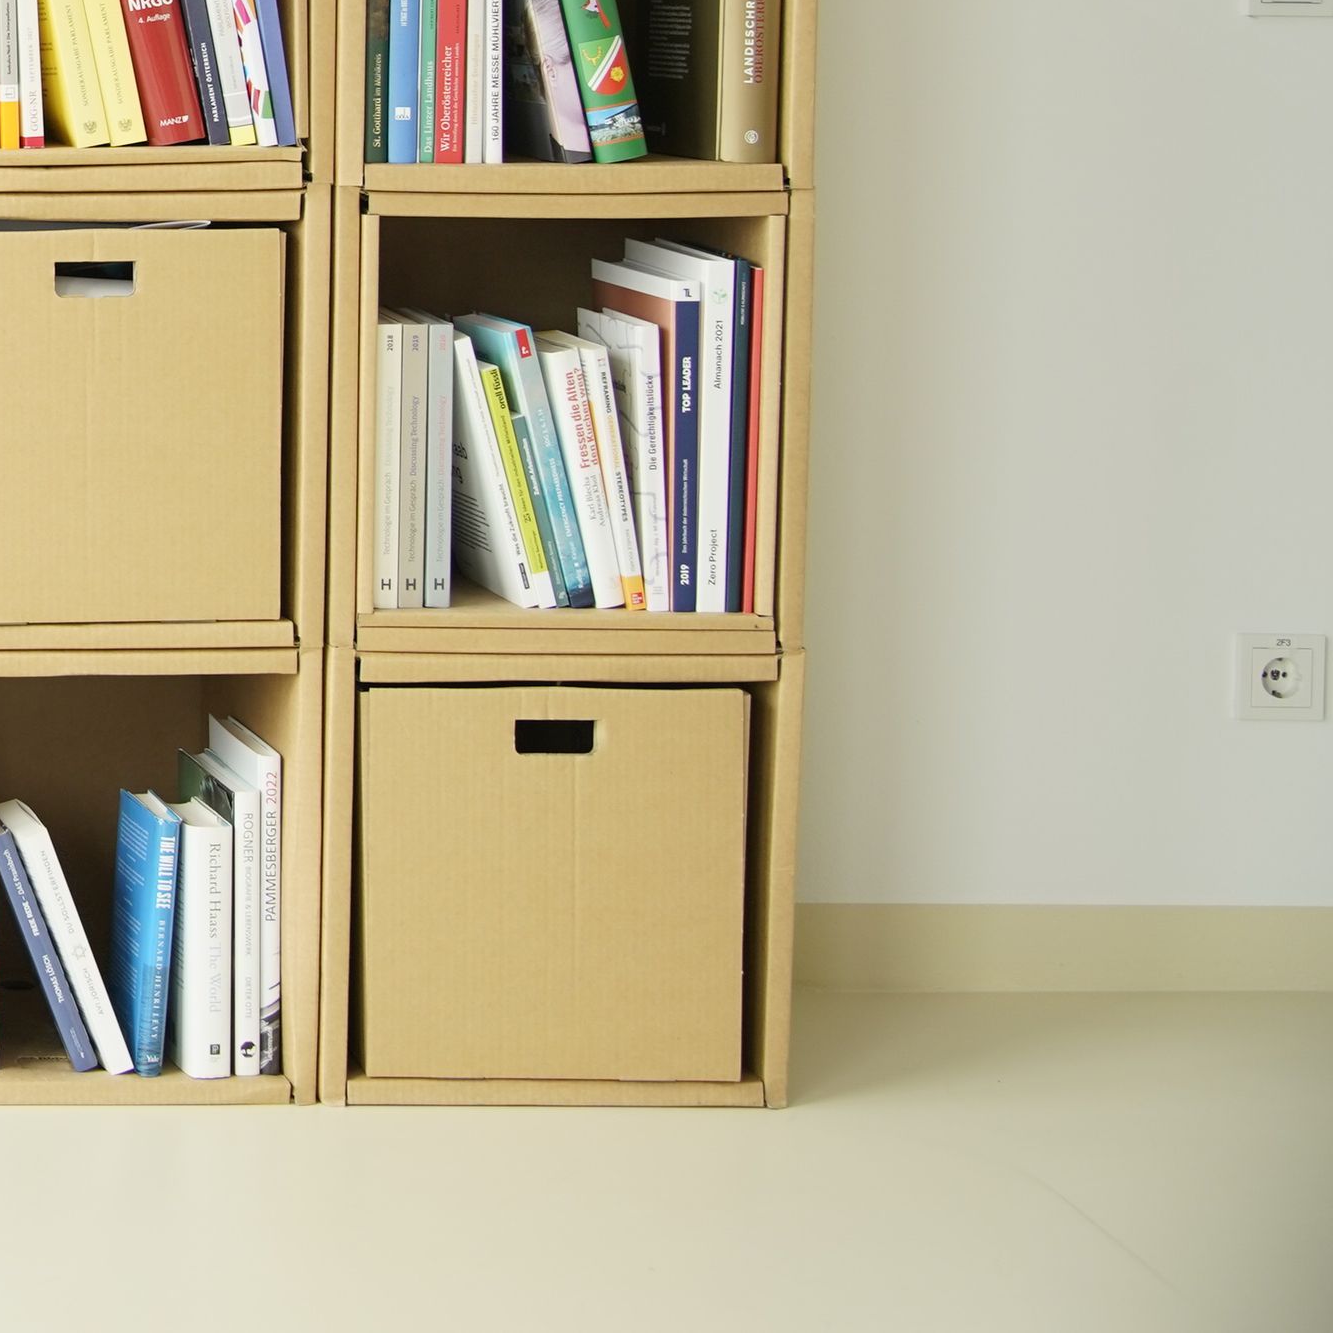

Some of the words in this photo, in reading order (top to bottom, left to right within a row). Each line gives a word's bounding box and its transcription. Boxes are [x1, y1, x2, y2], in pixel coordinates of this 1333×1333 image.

[145, 12, 172, 24] Auflage
[199, 42, 213, 83] ÖSTERREICH
[491, 54, 500, 88] MESSE
[424, 60, 434, 104] Landhaus
[440, 45, 453, 131] Oberösterreicher
[206, 84, 220, 123] PARLAMENT
[372, 97, 383, 135] Gotthard
[491, 90, 500, 124] JAHRE
[159, 116, 183, 129] MANZ
[424, 105, 434, 134] Linzer
[491, 125, 500, 142] 160
[424, 136, 434, 153] Das
[440, 133, 452, 152] Wir
[386, 334, 394, 352] 2018
[411, 334, 420, 352] 2019
[714, 319, 724, 342] 2021
[488, 368, 503, 391] füssli
[681, 356, 692, 391] LEADER
[713, 343, 723, 389] Almanach
[494, 391, 506, 410] orell
[564, 371, 580, 402] Alten
[409, 395, 420, 437] Technology
[570, 403, 583, 423] die
[645, 374, 657, 455] Gerechtigkeitslücke
[681, 392, 692, 413] TOP
[409, 437, 419, 477] Discussing
[573, 424, 591, 470] Fressen
[600, 371, 612, 414] REFRAMING
[615, 471, 629, 523] STEREOTYPES
[647, 455, 658, 471] Die
[708, 528, 718, 563] Project
[679, 564, 691, 585] 2019
[707, 564, 717, 585] Zero
[265, 771, 278, 805] 2022
[159, 836, 176, 854] THE
[242, 812, 254, 863] ROGNER
[157, 855, 175, 877] WILL
[208, 842, 222, 895] Richard
[264, 810, 278, 922] PAMMESBERGER
[156, 879, 174, 892] TO
[155, 892, 173, 910] SEE
[208, 900, 222, 939] Haass
[41, 954, 54, 977] LÖSCH
[208, 941, 221, 968] The
[49, 976, 65, 1004] THOMAS
[208, 973, 222, 1014] World
